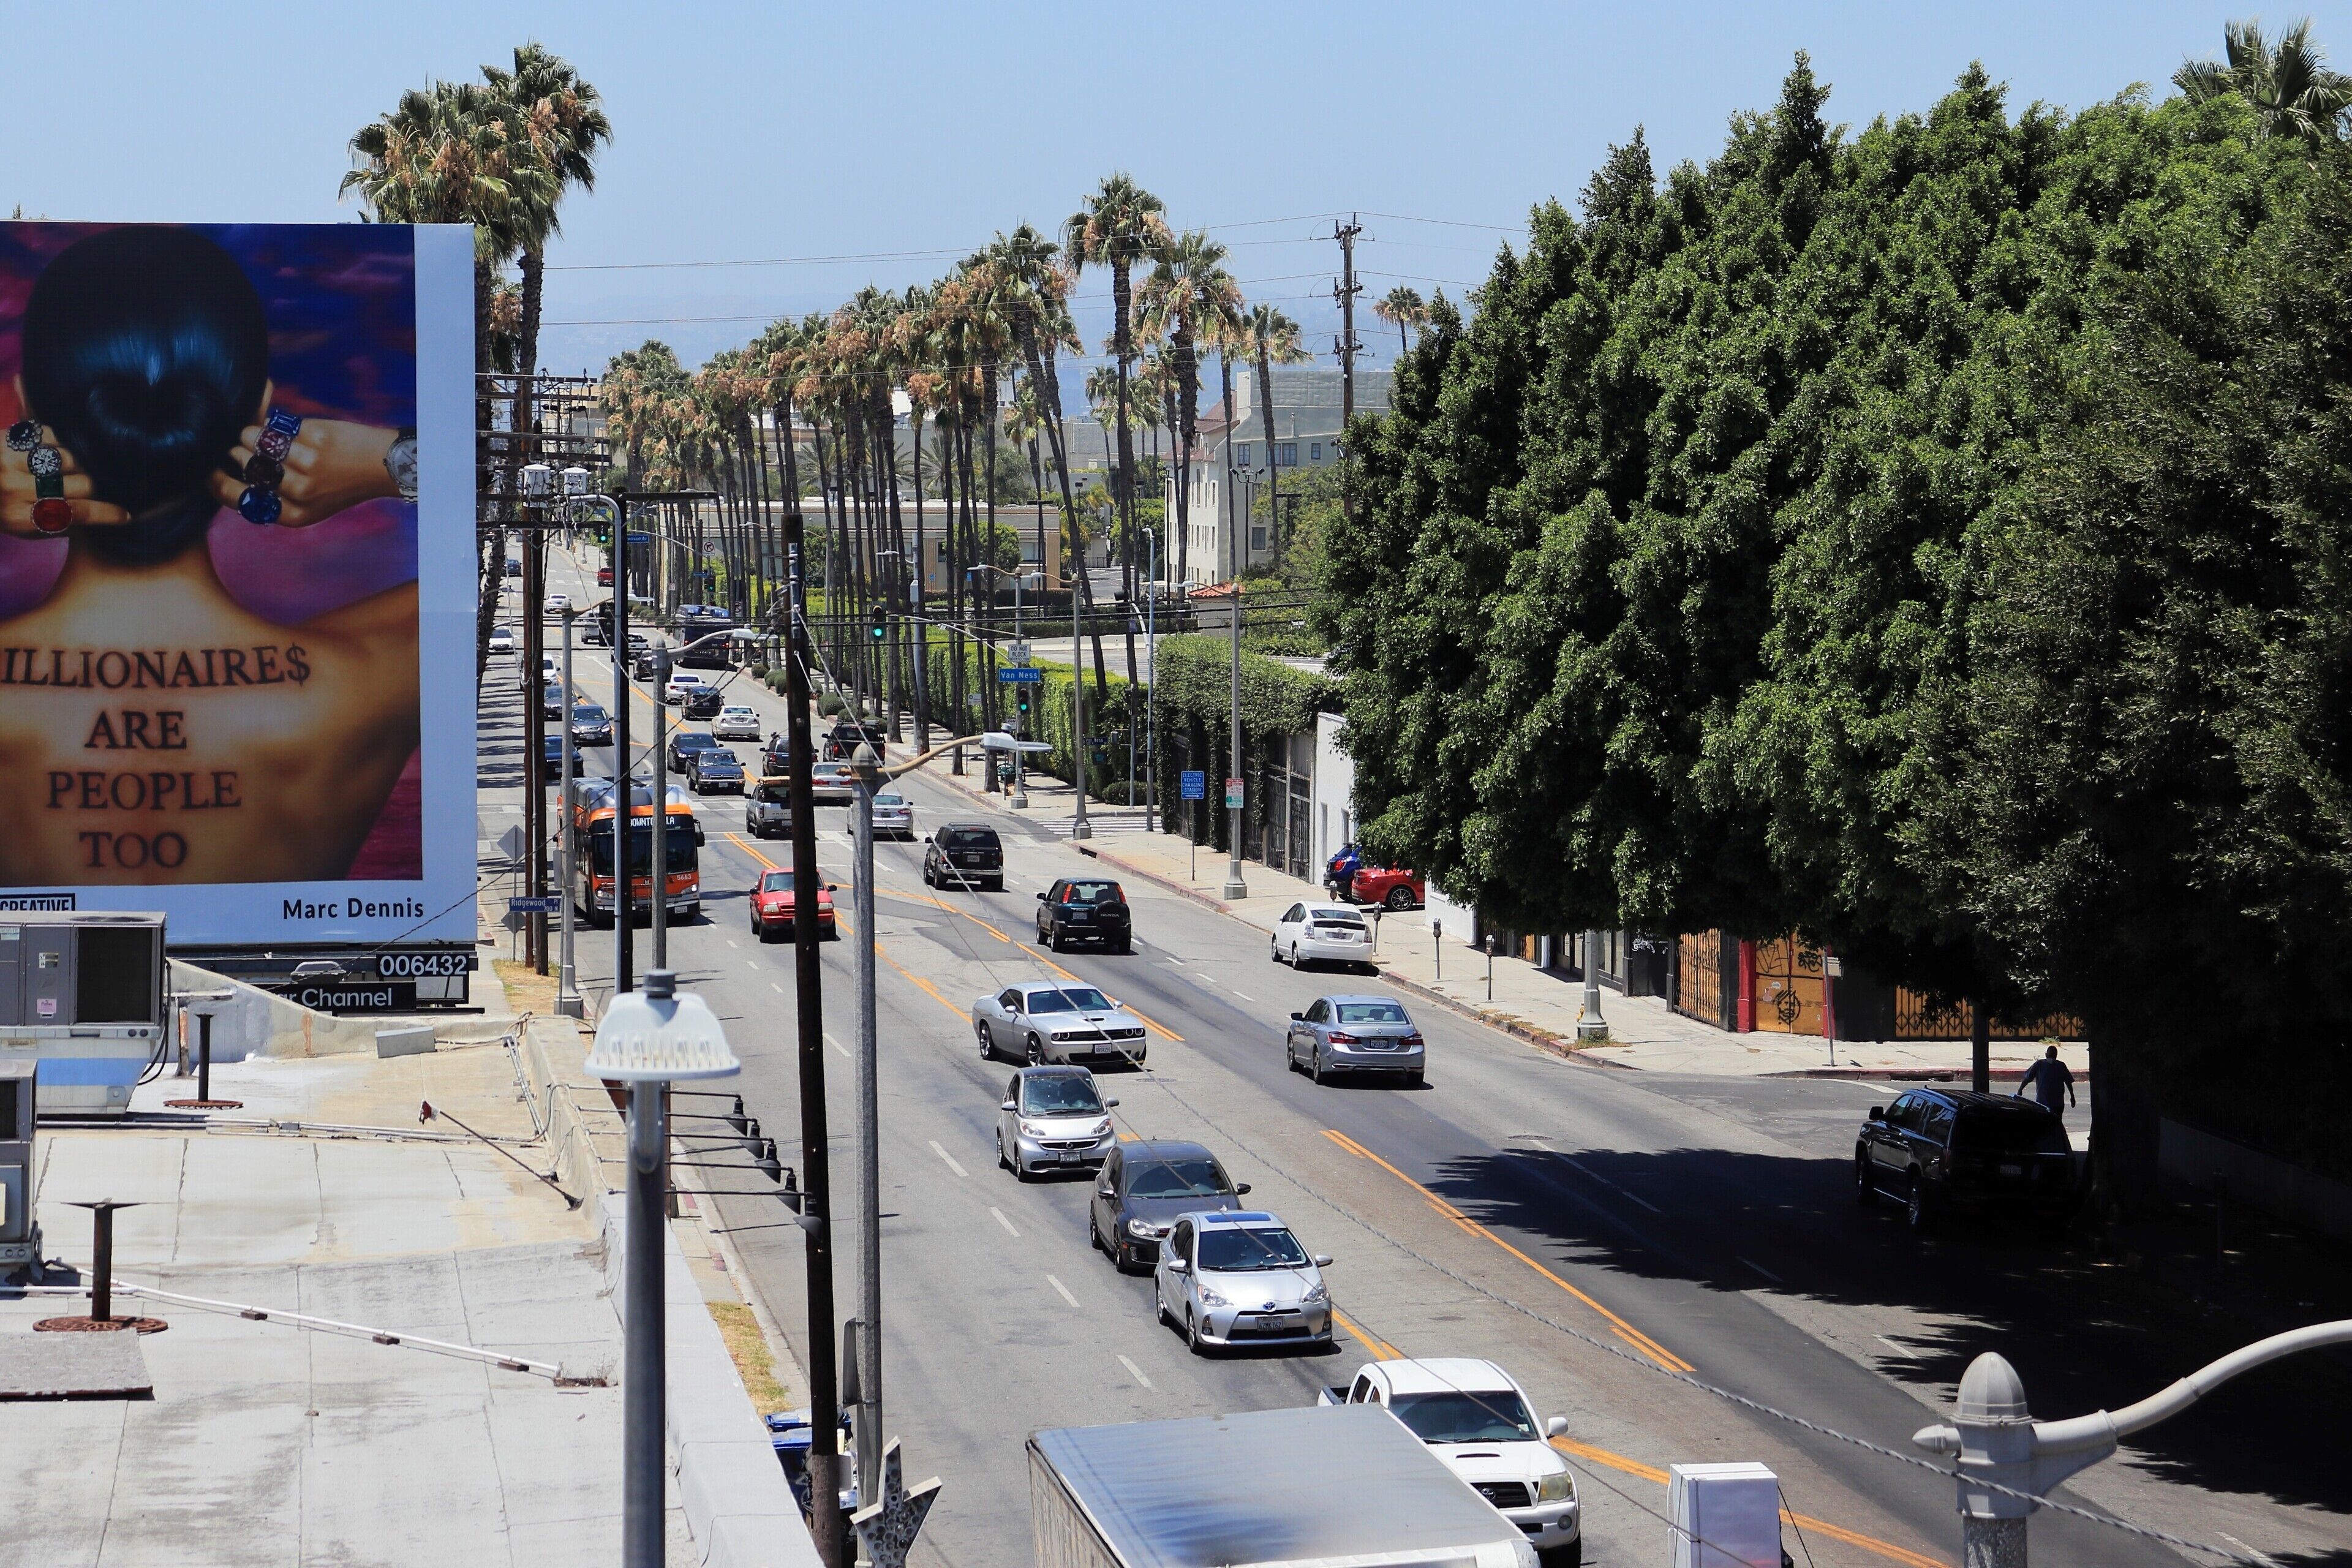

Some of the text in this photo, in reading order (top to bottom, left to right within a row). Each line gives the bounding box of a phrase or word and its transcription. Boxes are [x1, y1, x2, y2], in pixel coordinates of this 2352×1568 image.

[85, 711, 186, 749] ARE
[46, 771, 241, 810] PEOPLE
[79, 831, 189, 869] TOO
[1, 899, 69, 911] CREATIVE
[283, 897, 424, 919] Marc Dennis
[511, 899, 546, 908] Ridgewood
[380, 956, 467, 976] 006432
[301, 987, 392, 1007] Channel
